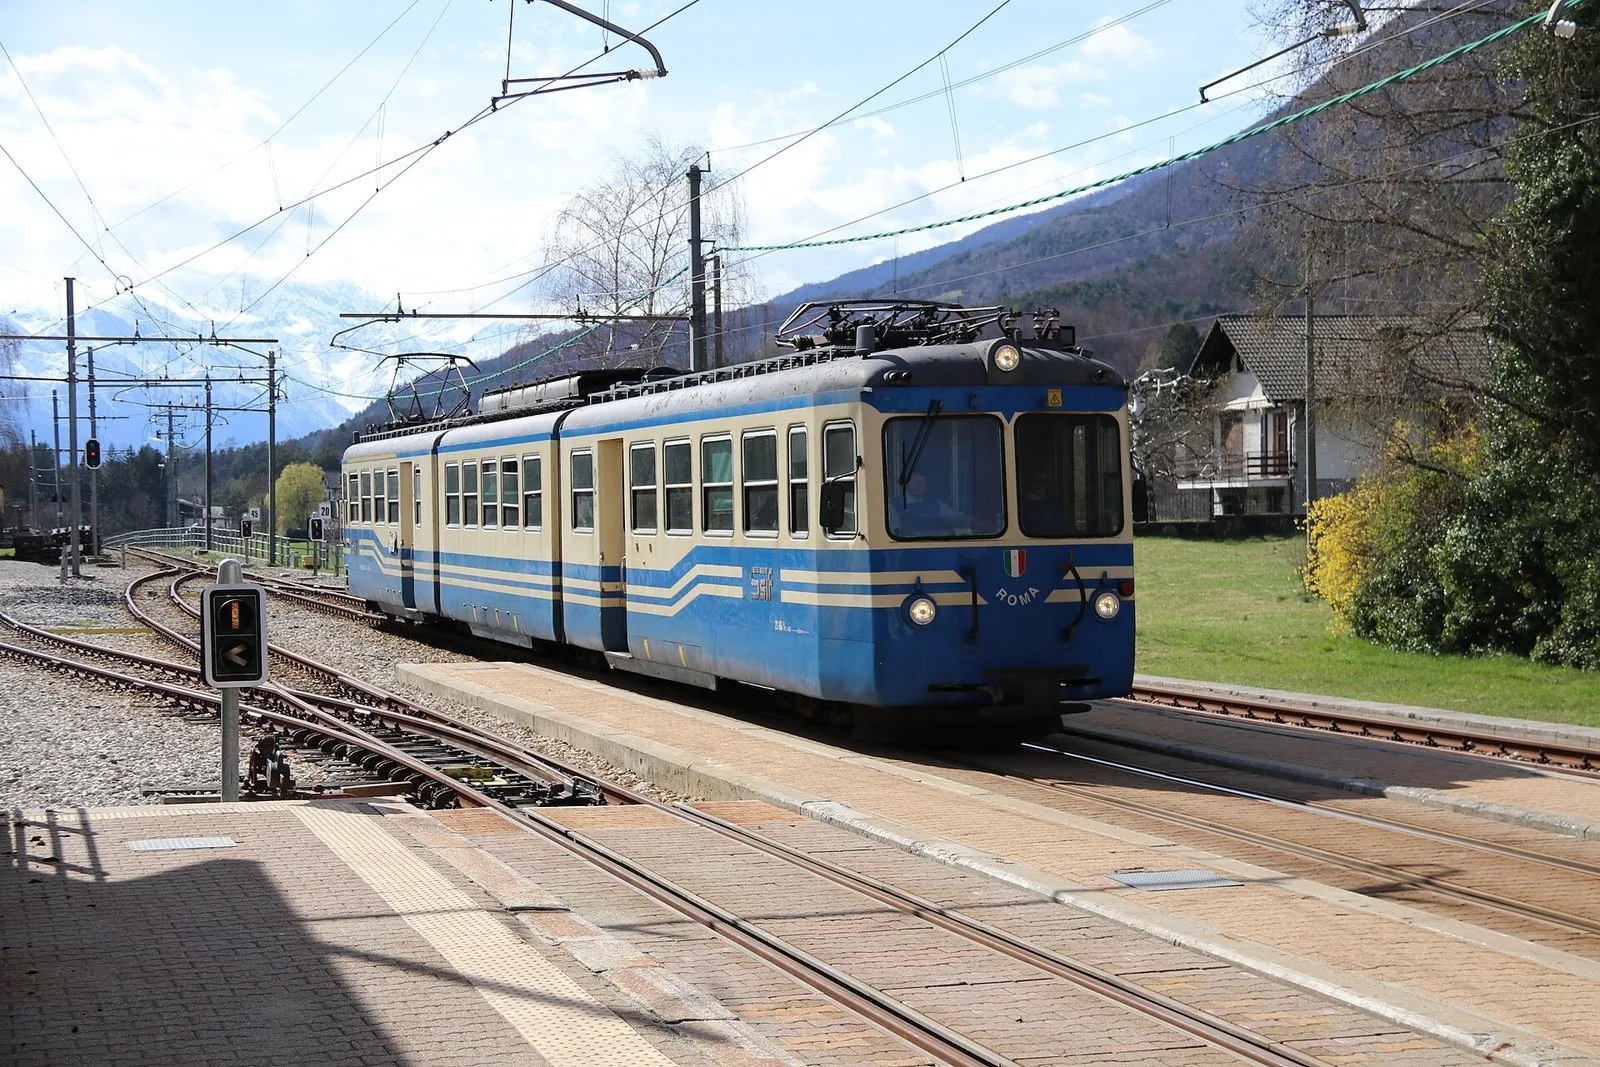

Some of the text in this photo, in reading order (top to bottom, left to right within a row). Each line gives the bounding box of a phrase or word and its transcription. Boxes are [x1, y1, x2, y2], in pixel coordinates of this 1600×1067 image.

[250, 510, 259, 519] 45
[320, 506, 330, 517] 20
[995, 587, 1040, 606] ROMA
